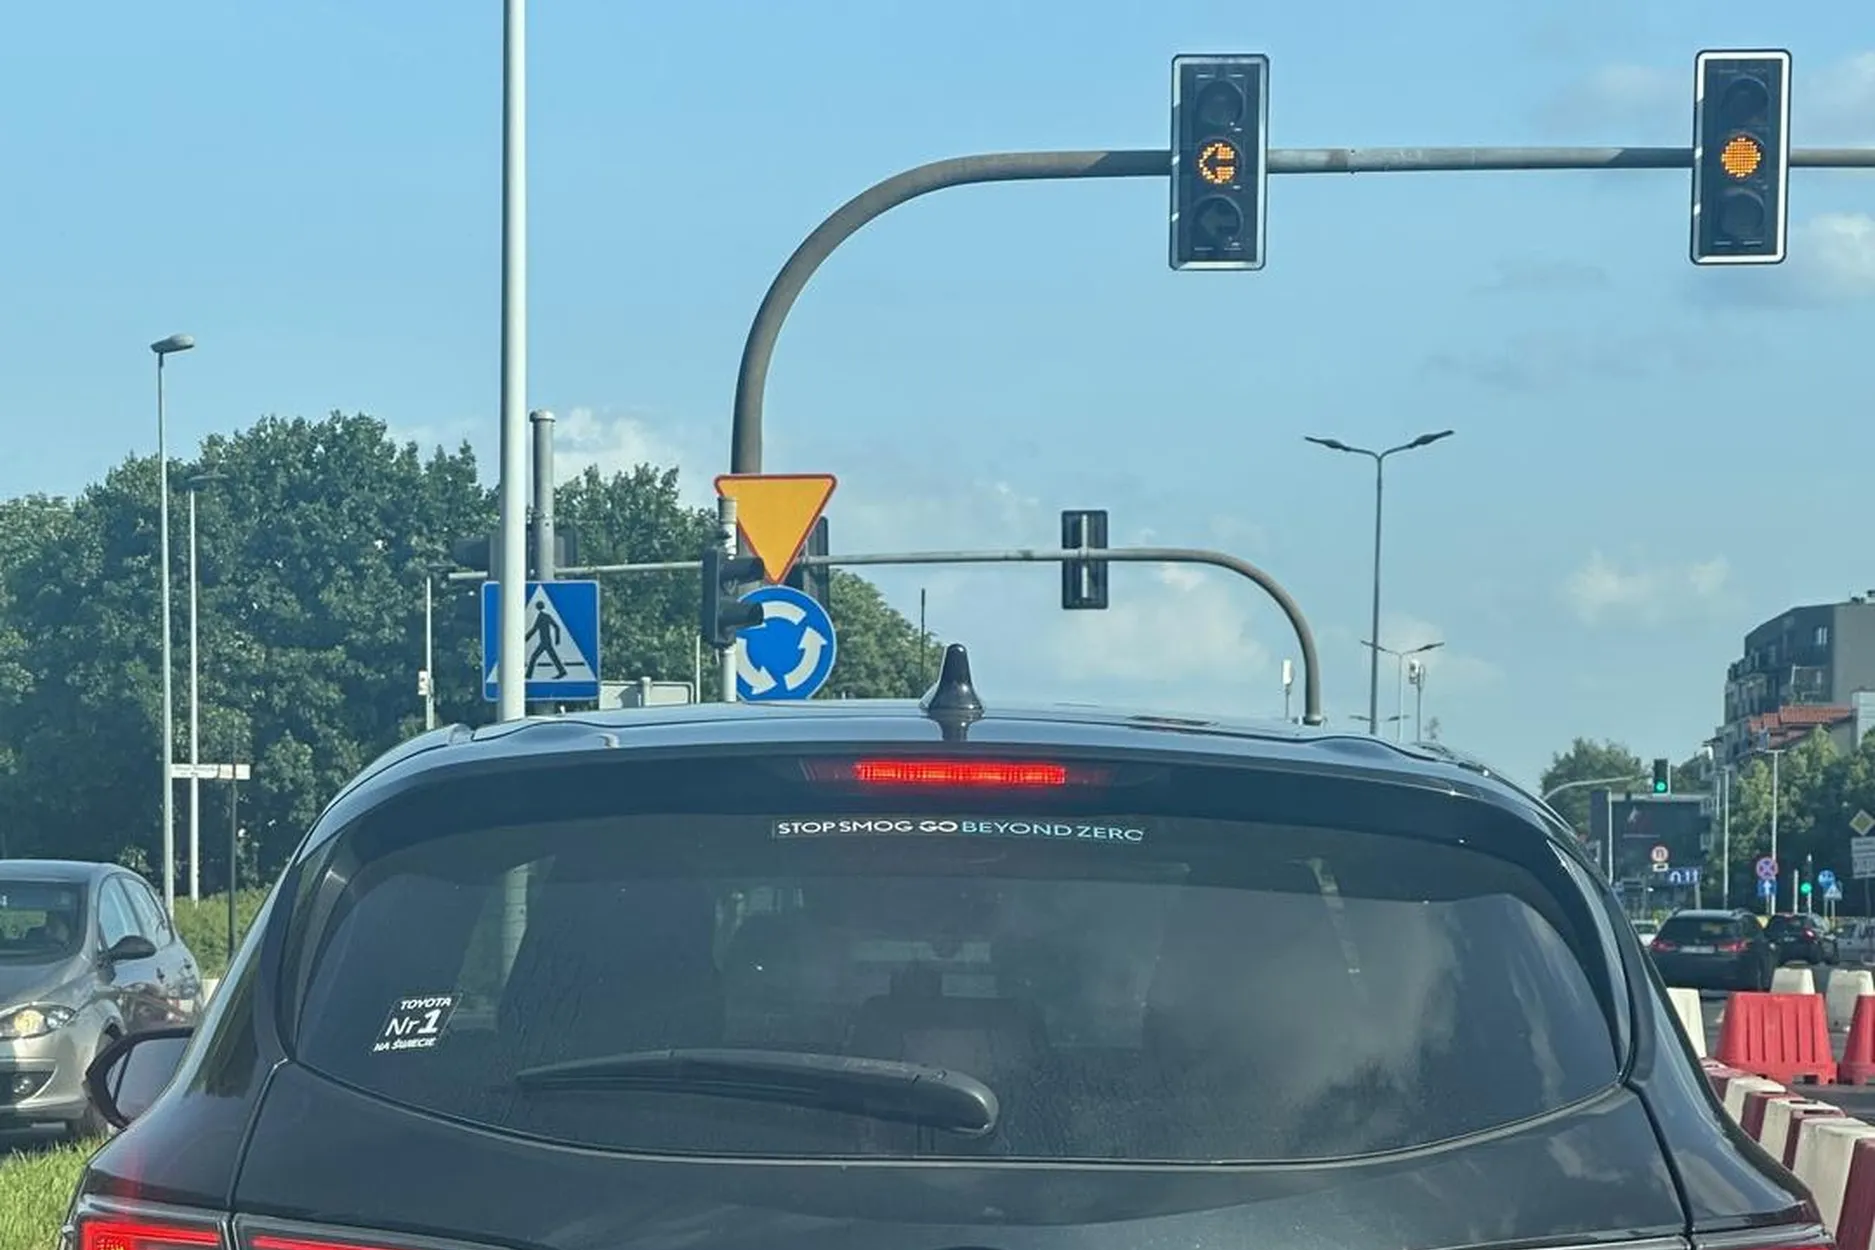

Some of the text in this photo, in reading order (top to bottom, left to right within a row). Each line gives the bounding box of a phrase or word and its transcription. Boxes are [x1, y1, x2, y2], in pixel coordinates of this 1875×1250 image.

[778, 820, 1144, 842] STOP SMOG GO BEYOND ZERO
[400, 997, 452, 1010] TOYOTA
[385, 1008, 441, 1037] Nr 1
[373, 1042, 390, 1052] NA
